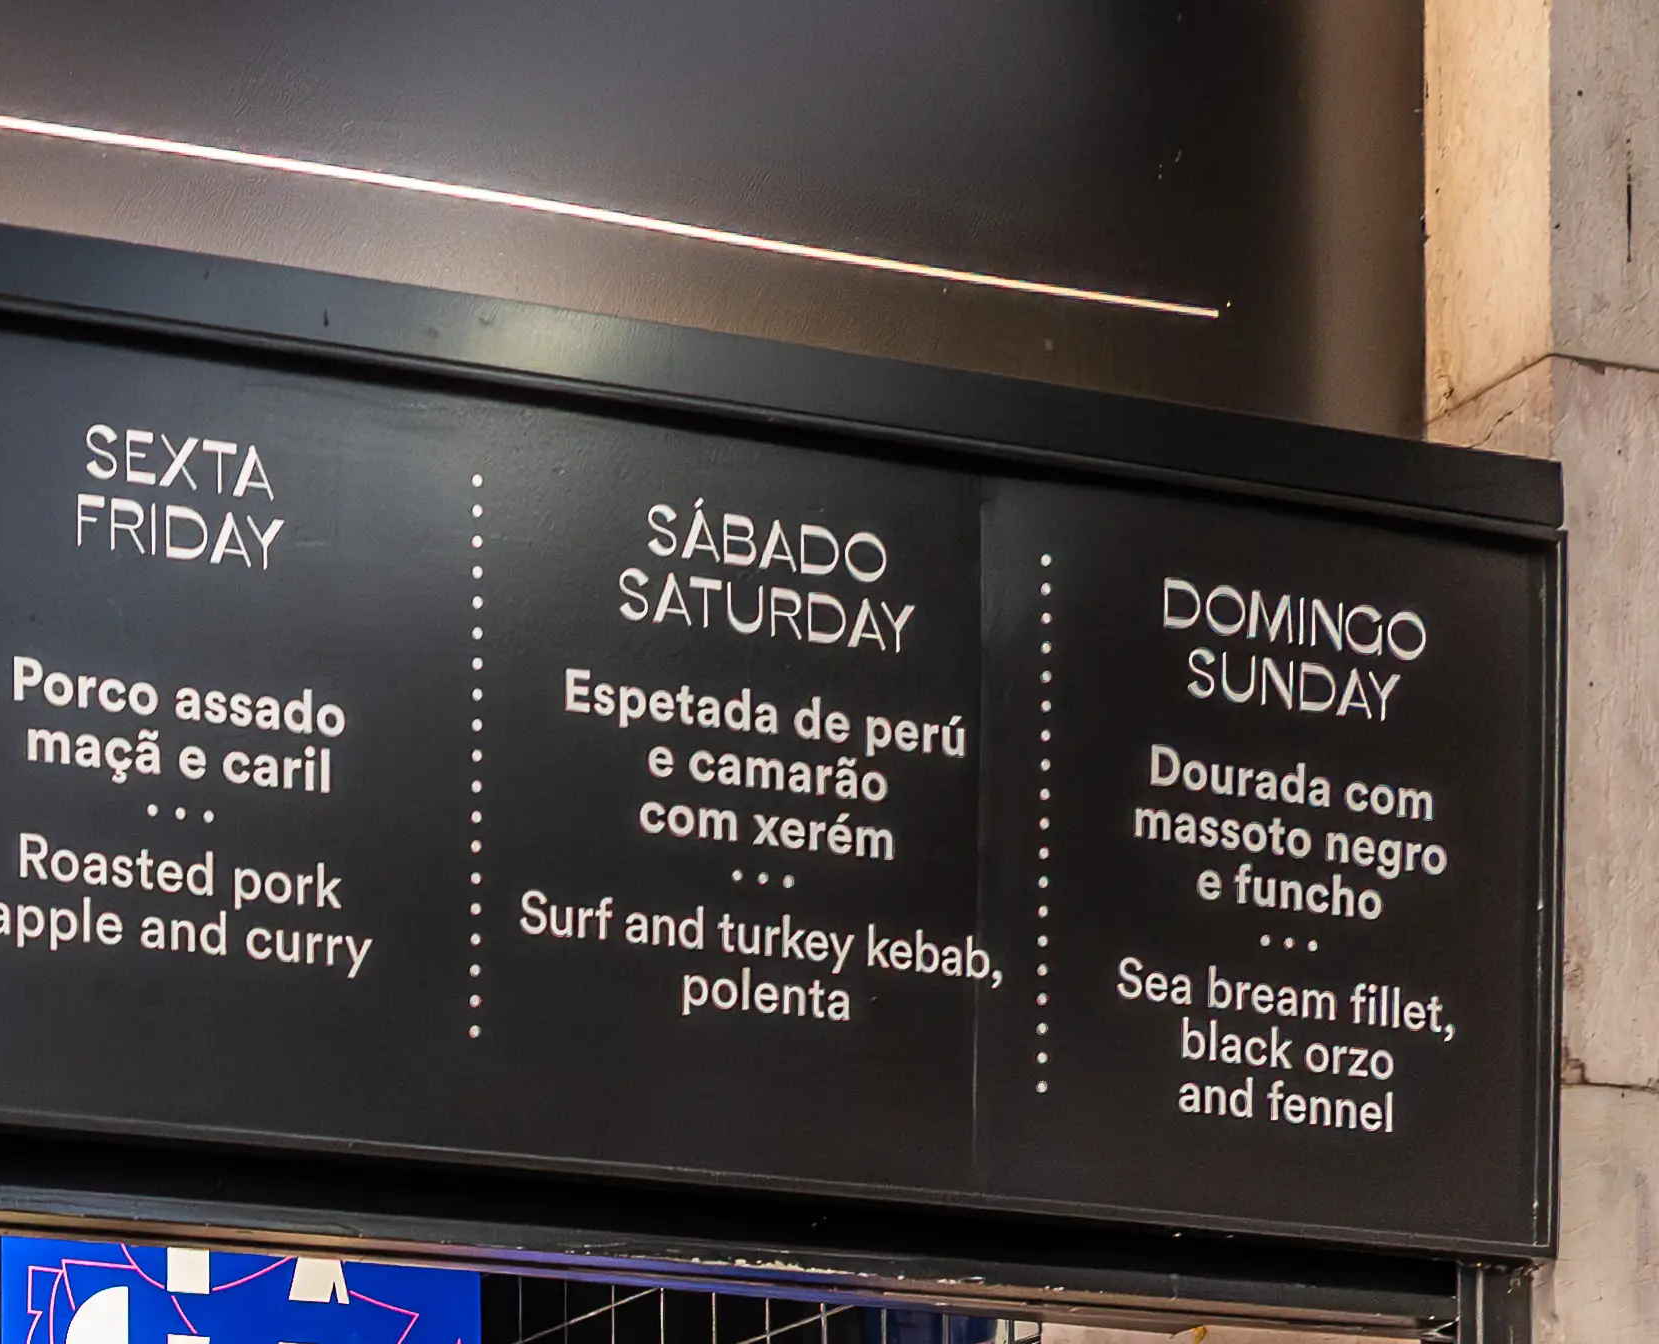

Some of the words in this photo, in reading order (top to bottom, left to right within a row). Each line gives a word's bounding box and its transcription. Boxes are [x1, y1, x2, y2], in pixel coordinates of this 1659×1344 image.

[87, 425, 274, 501] SEXTA
[78, 494, 284, 570] FRIDAY
[648, 498, 886, 582] SÁBADO
[619, 568, 915, 653] SATURDAY
[1164, 578, 1426, 660] DOMINGO
[14, 656, 158, 715] Porco
[176, 688, 345, 737] assado
[1188, 649, 1400, 721] SUNDAY
[28, 729, 160, 783] maçã
[179, 746, 206, 779] e
[223, 746, 330, 793] caril
[1151, 744, 1330, 807] Dourada
[1345, 783, 1432, 820] com
[20, 833, 213, 896] Roasted
[235, 863, 341, 910] pork
[1135, 808, 1311, 858] massoto
[1327, 833, 1447, 879] negro
[1197, 870, 1221, 900] e
[1234, 864, 1381, 919] funcho
[141, 910, 226, 955] and
[246, 928, 372, 978] curry
[1117, 957, 1191, 1004] Sea
[1208, 966, 1335, 1020] bream
[1350, 983, 1454, 1041] fillet,
[1182, 1017, 1292, 1069] black
[1306, 1043, 1393, 1080] orzo
[1179, 1077, 1253, 1118] and
[1267, 1080, 1393, 1132] fennel
